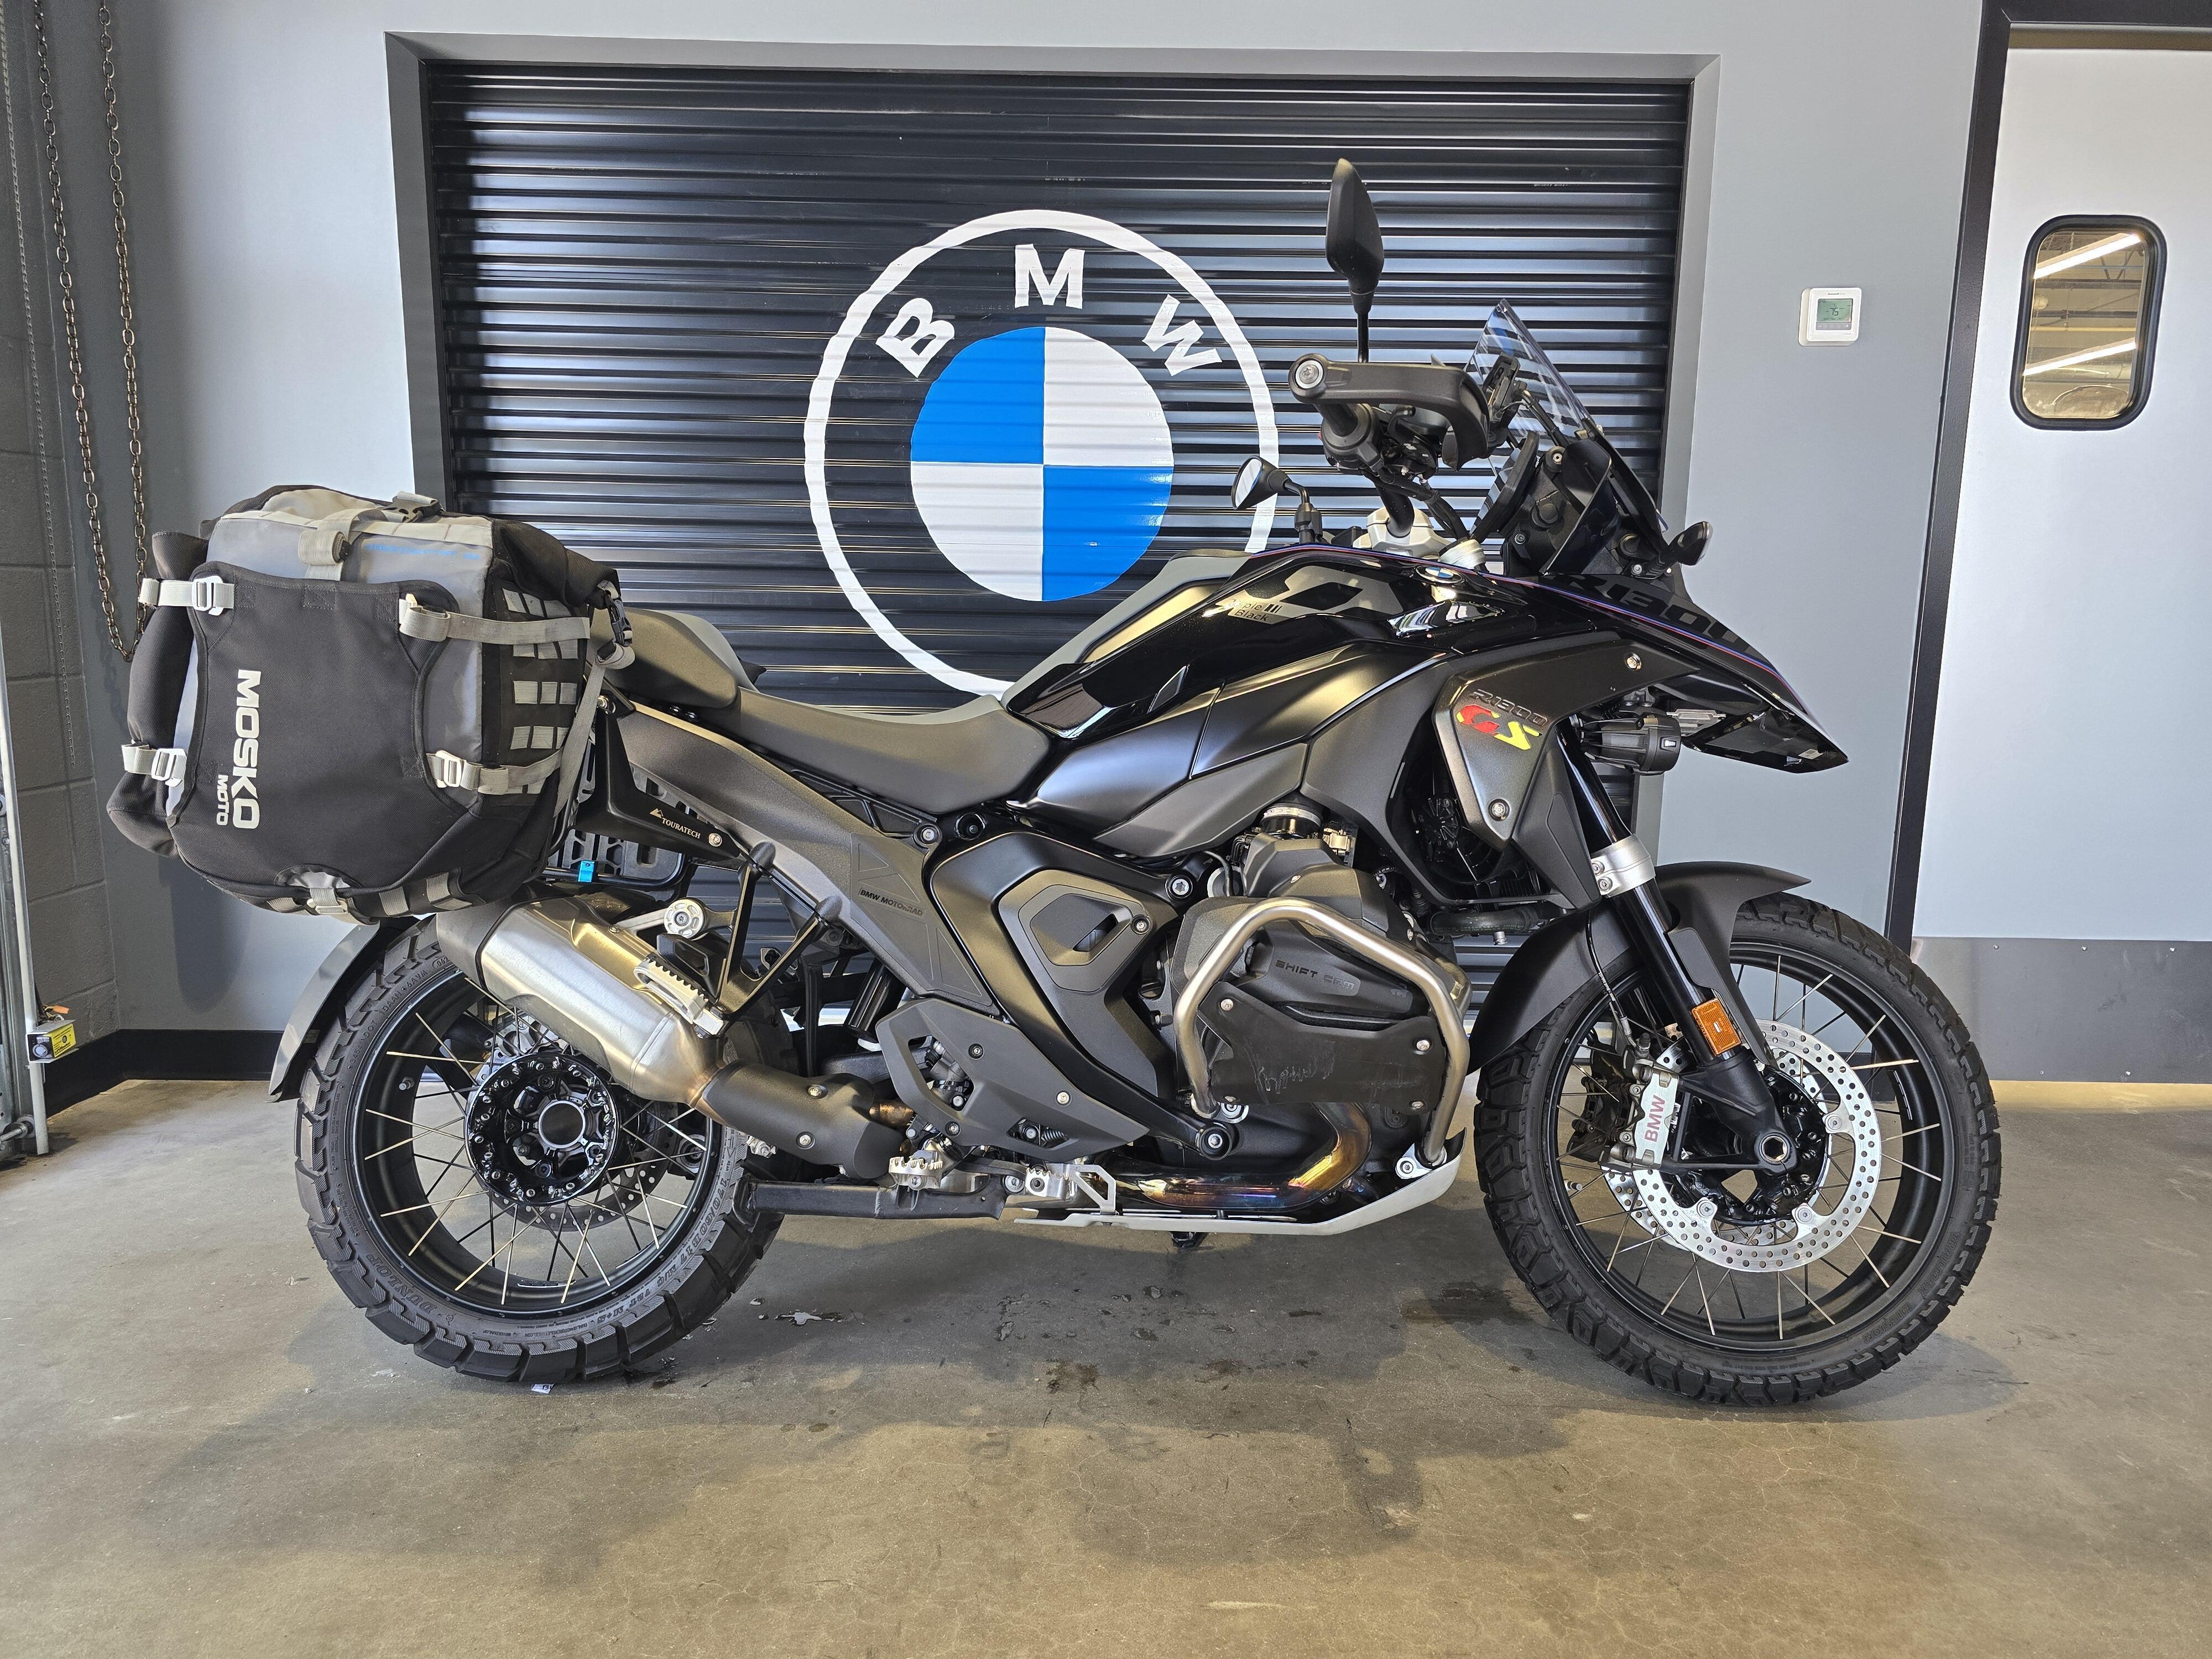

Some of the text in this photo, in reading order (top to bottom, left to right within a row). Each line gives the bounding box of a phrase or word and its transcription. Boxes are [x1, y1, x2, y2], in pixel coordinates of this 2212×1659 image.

[875, 243, 1223, 378] BMW
[1830, 307, 1839, 316] 75
[1230, 599, 1262, 610] Tiple
[1234, 609, 1269, 621] Black
[1456, 704, 1542, 750] GS
[1469, 688, 1548, 727] R1300
[232, 670, 262, 829] MOSKO
[216, 774, 228, 826] MOTO
[662, 817, 701, 839] TOURATECH
[860, 889, 923, 916] BMW MOTORRAD
[1275, 959, 1318, 978] SHIFT
[363, 1019, 377, 1037] DOT
[1644, 1094, 1666, 1142] BMW
[366, 1254, 437, 1314] DUNLOP
[1863, 1232, 1959, 1343] TRAILMAX MISSION
